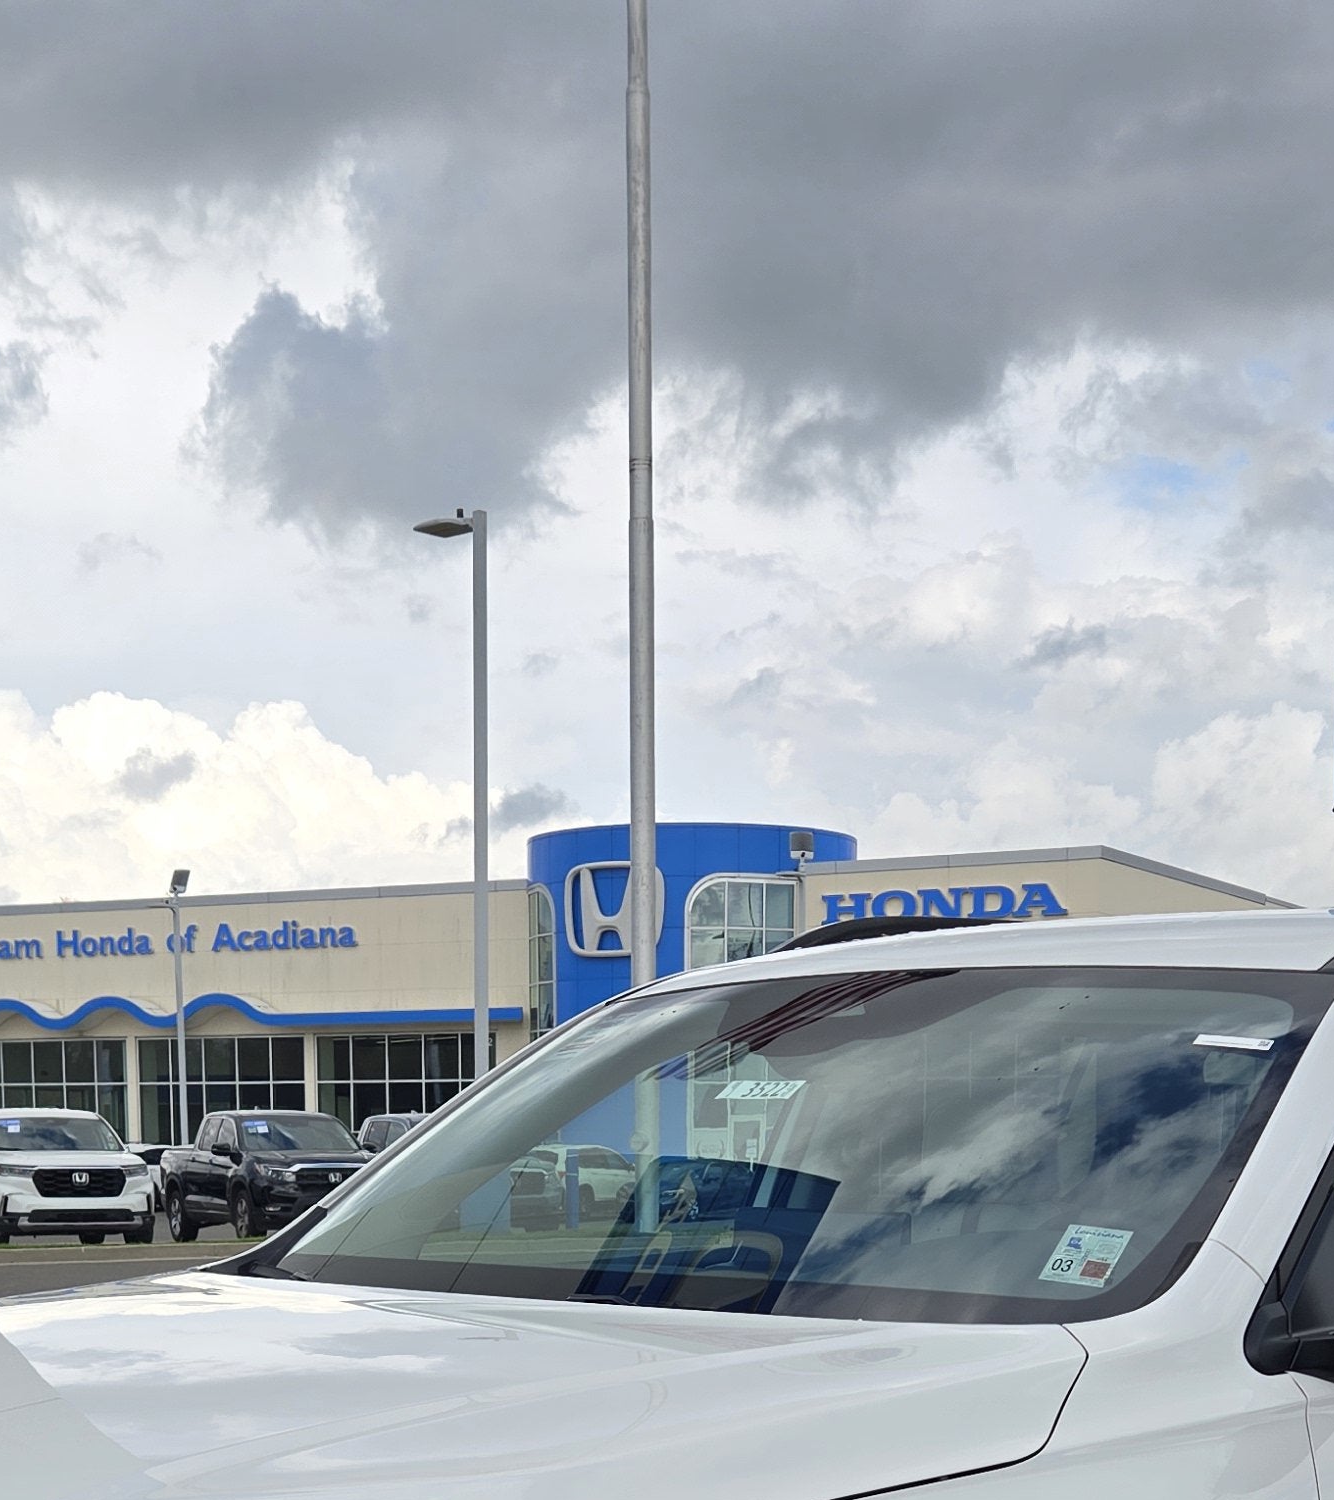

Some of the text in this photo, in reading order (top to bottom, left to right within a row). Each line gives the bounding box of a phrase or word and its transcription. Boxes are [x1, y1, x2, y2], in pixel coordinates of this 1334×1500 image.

[820, 883, 1068, 926] HONDA
[56, 927, 154, 958] Honda
[166, 924, 199, 953] of
[211, 920, 359, 952] Acadiana
[1074, 1226, 1124, 1240] Louisiana
[1051, 1258, 1074, 1273] 03
